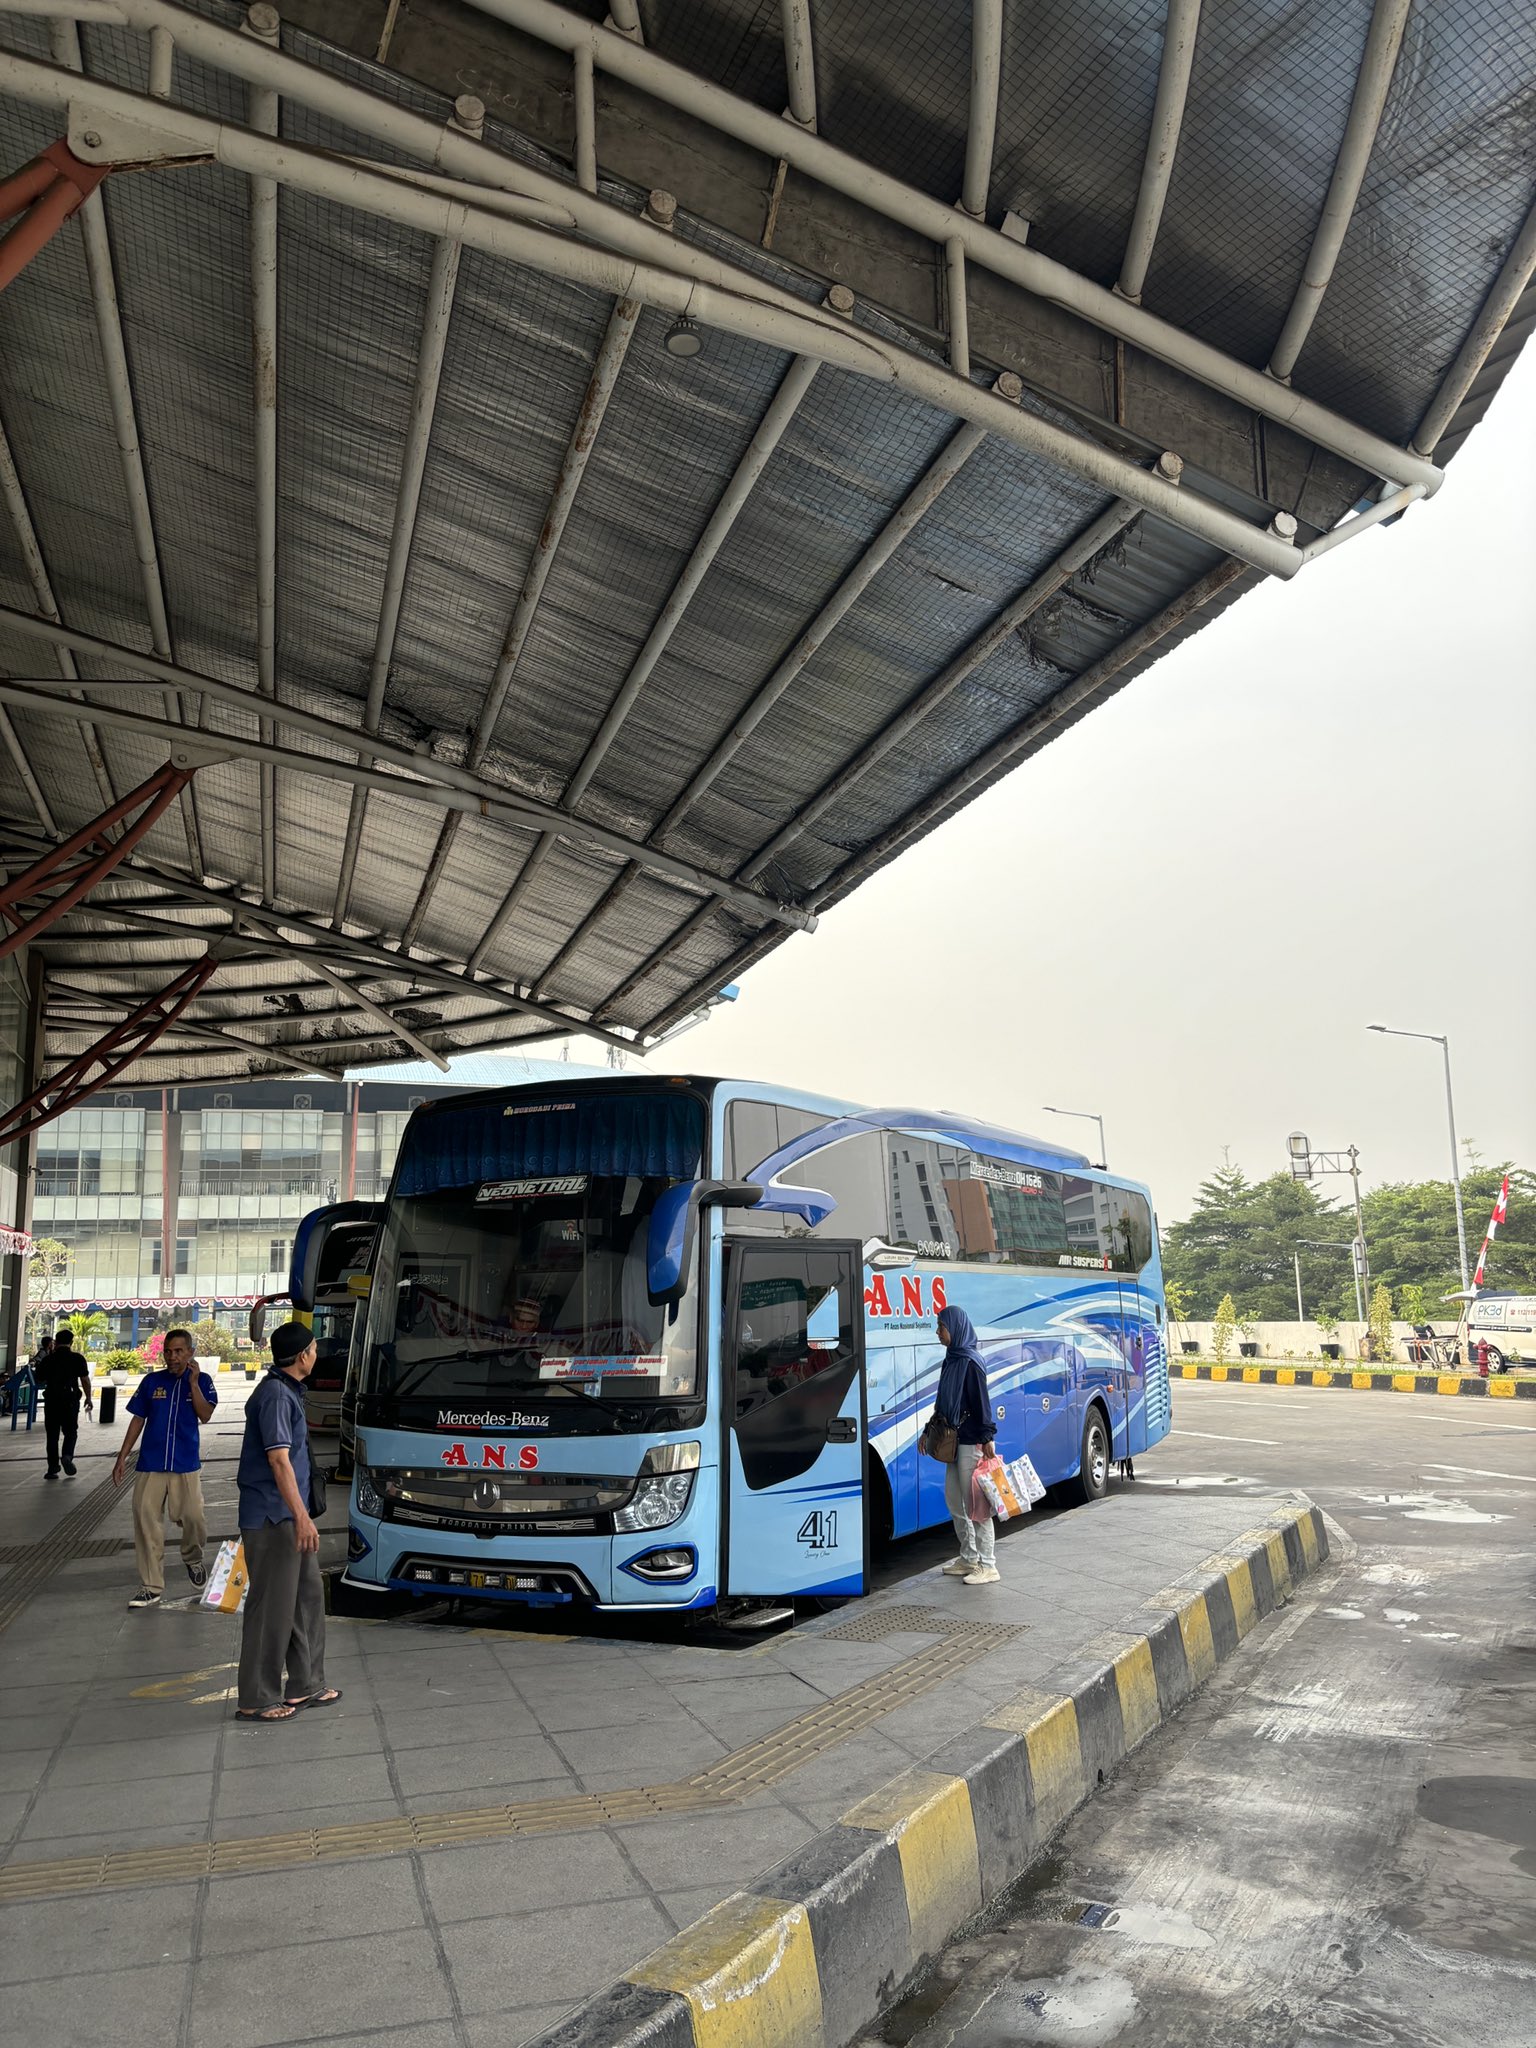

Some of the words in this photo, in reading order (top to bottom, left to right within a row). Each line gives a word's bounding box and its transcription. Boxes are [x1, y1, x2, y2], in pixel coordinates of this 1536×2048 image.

[970, 1161, 1016, 1184] Mercedes-Benz
[1026, 1174, 1042, 1188] 1626
[1058, 1254, 1072, 1266] AIR
[437, 1410, 550, 1426] Mercedes-Benz
[441, 1518, 493, 1529] MORODADI
[796, 1510, 839, 1549] 41
